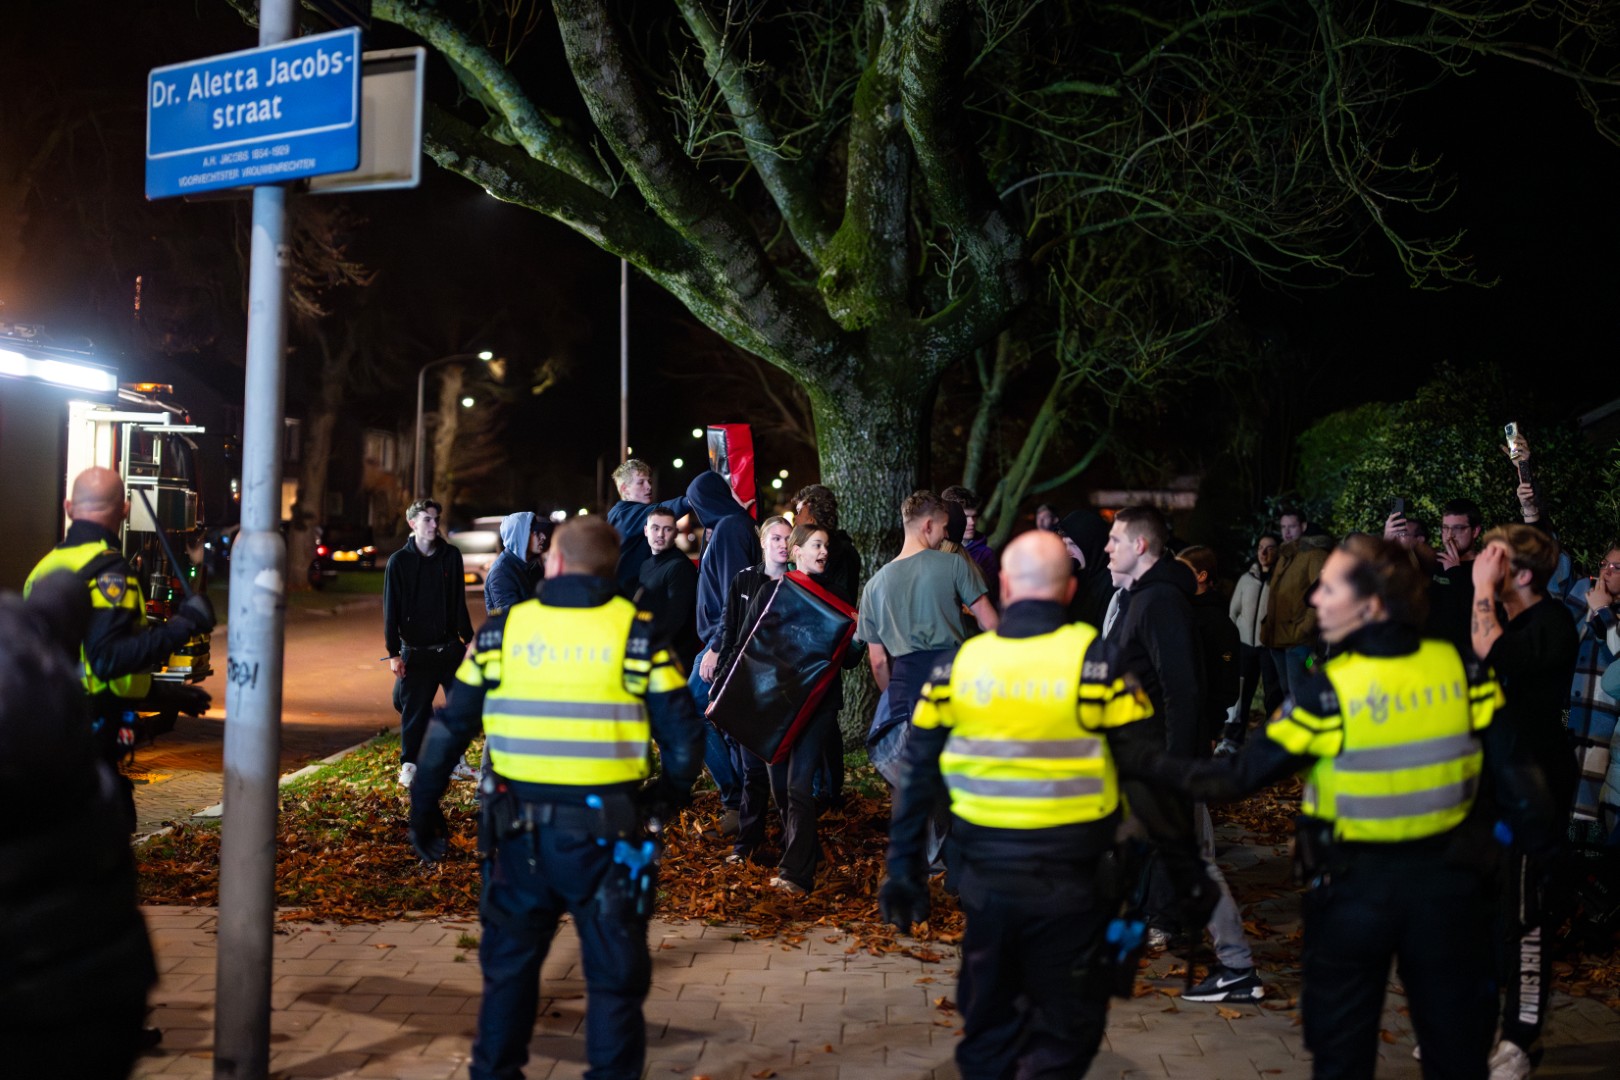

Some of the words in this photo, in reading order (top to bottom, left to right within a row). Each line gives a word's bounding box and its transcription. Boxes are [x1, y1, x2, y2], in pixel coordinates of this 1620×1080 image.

[152, 80, 180, 108] Dr.
[187, 67, 258, 102] Aletta
[265, 48, 353, 86] Jacobs-
[212, 95, 282, 130] straat
[219, 150, 250, 165] JACOBS
[1518, 975, 1541, 1025] SQUAD
